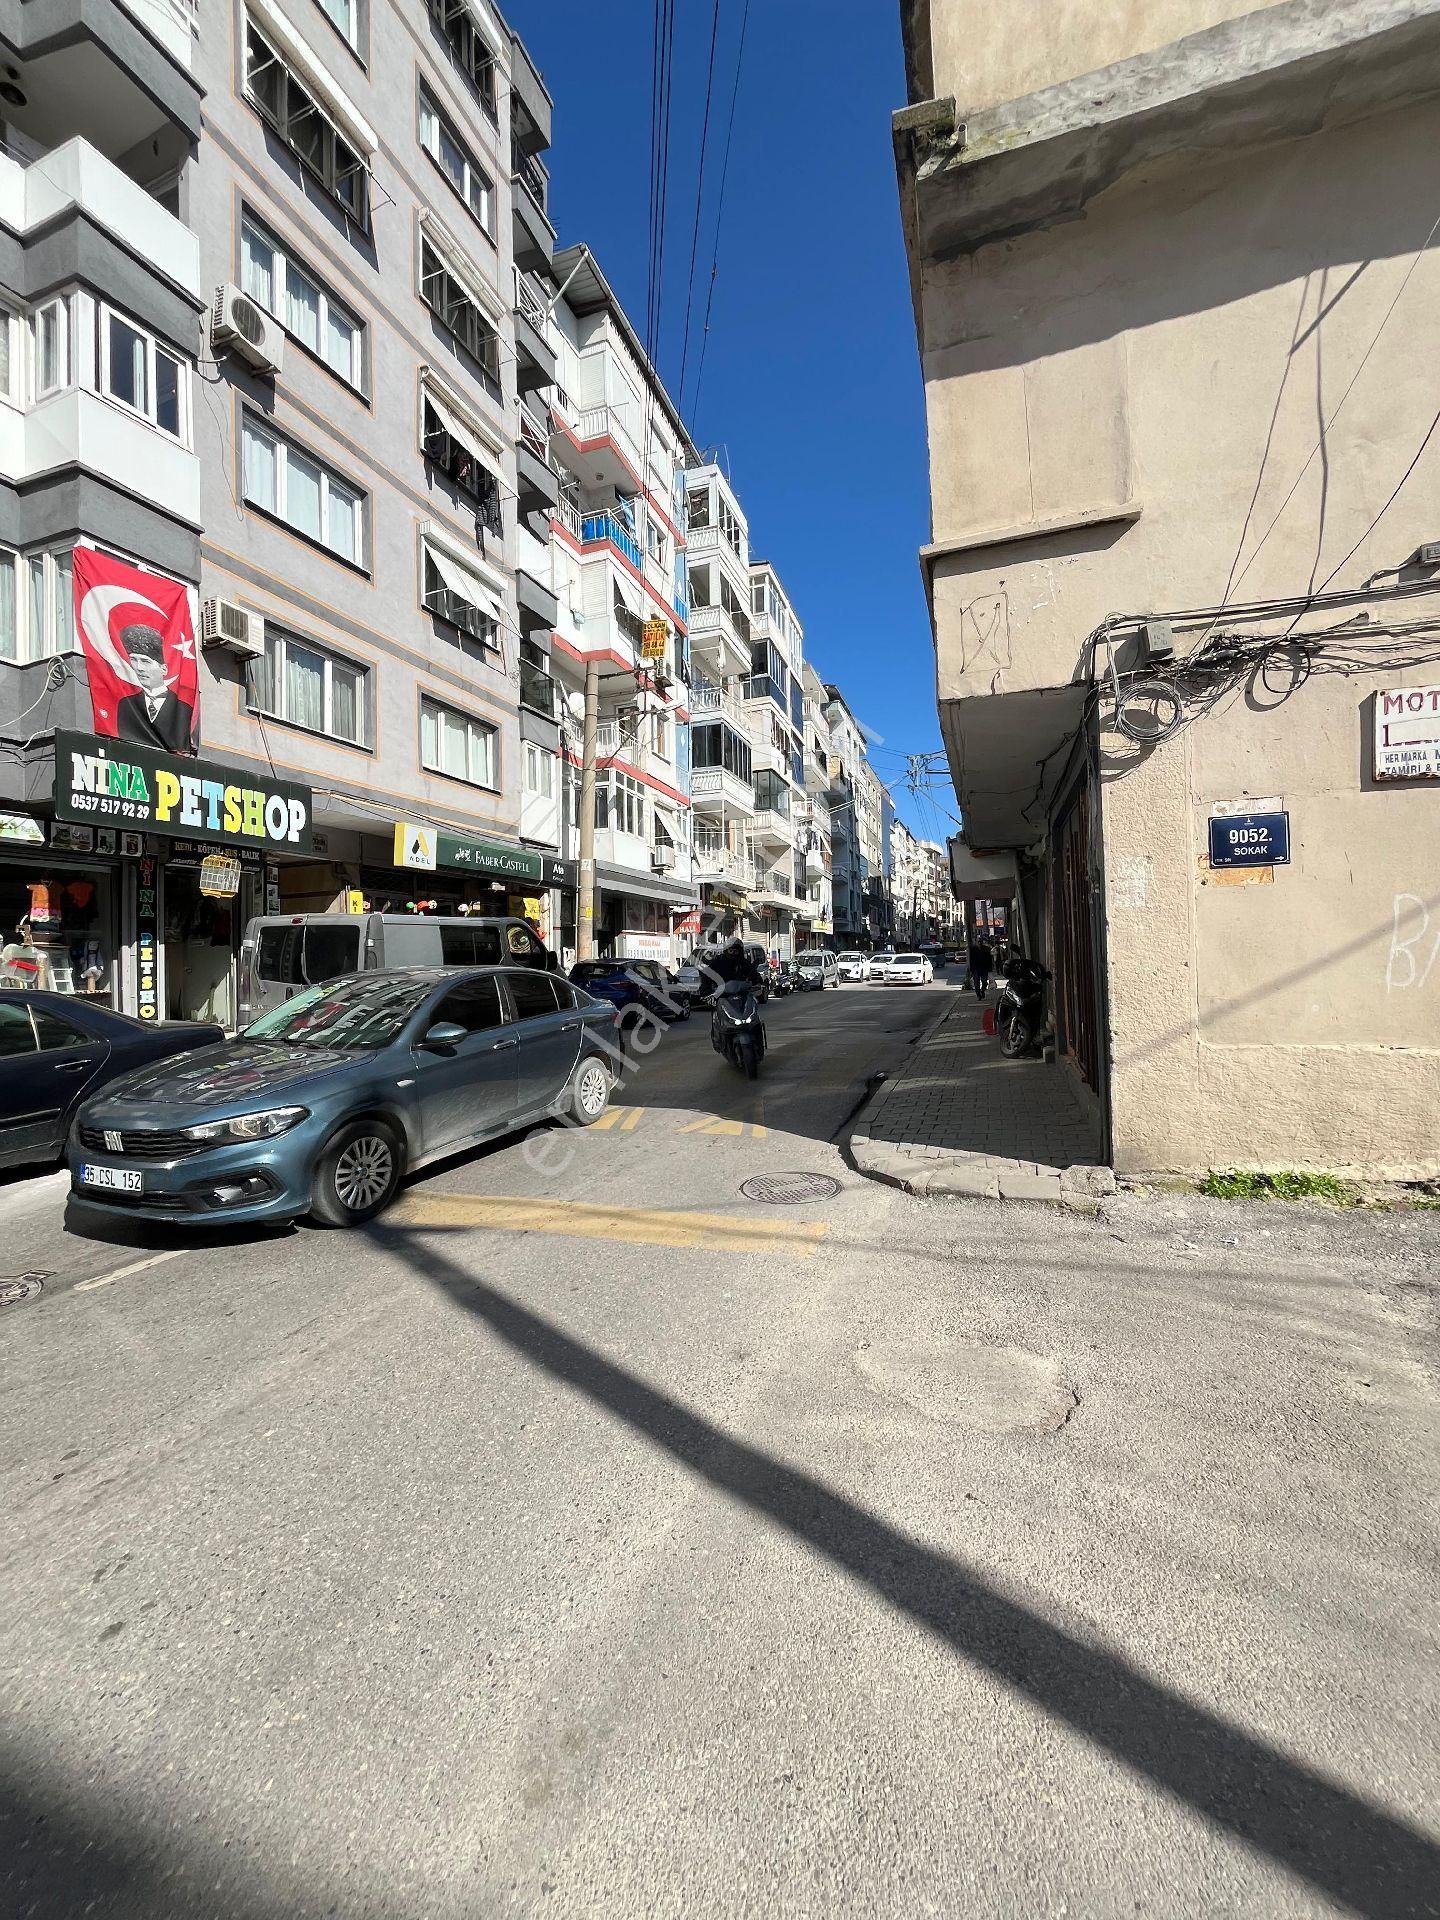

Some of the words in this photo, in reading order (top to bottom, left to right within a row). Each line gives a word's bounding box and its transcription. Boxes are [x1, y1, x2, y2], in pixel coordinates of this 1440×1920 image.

[1385, 753, 1400, 763] HER
[1401, 751, 1428, 761] MARKA
[71, 793, 99, 811] 0537
[100, 798, 121, 815] 517
[121, 802, 136, 817] 92
[137, 805, 150, 820] 29
[155, 769, 306, 843] PETSHOP
[1234, 845, 1268, 856] SOKAK
[408, 856, 431, 865] ADEL
[85, 1166, 95, 1182] 35
[99, 1168, 116, 1187] CSL
[122, 1172, 141, 1190] 152
